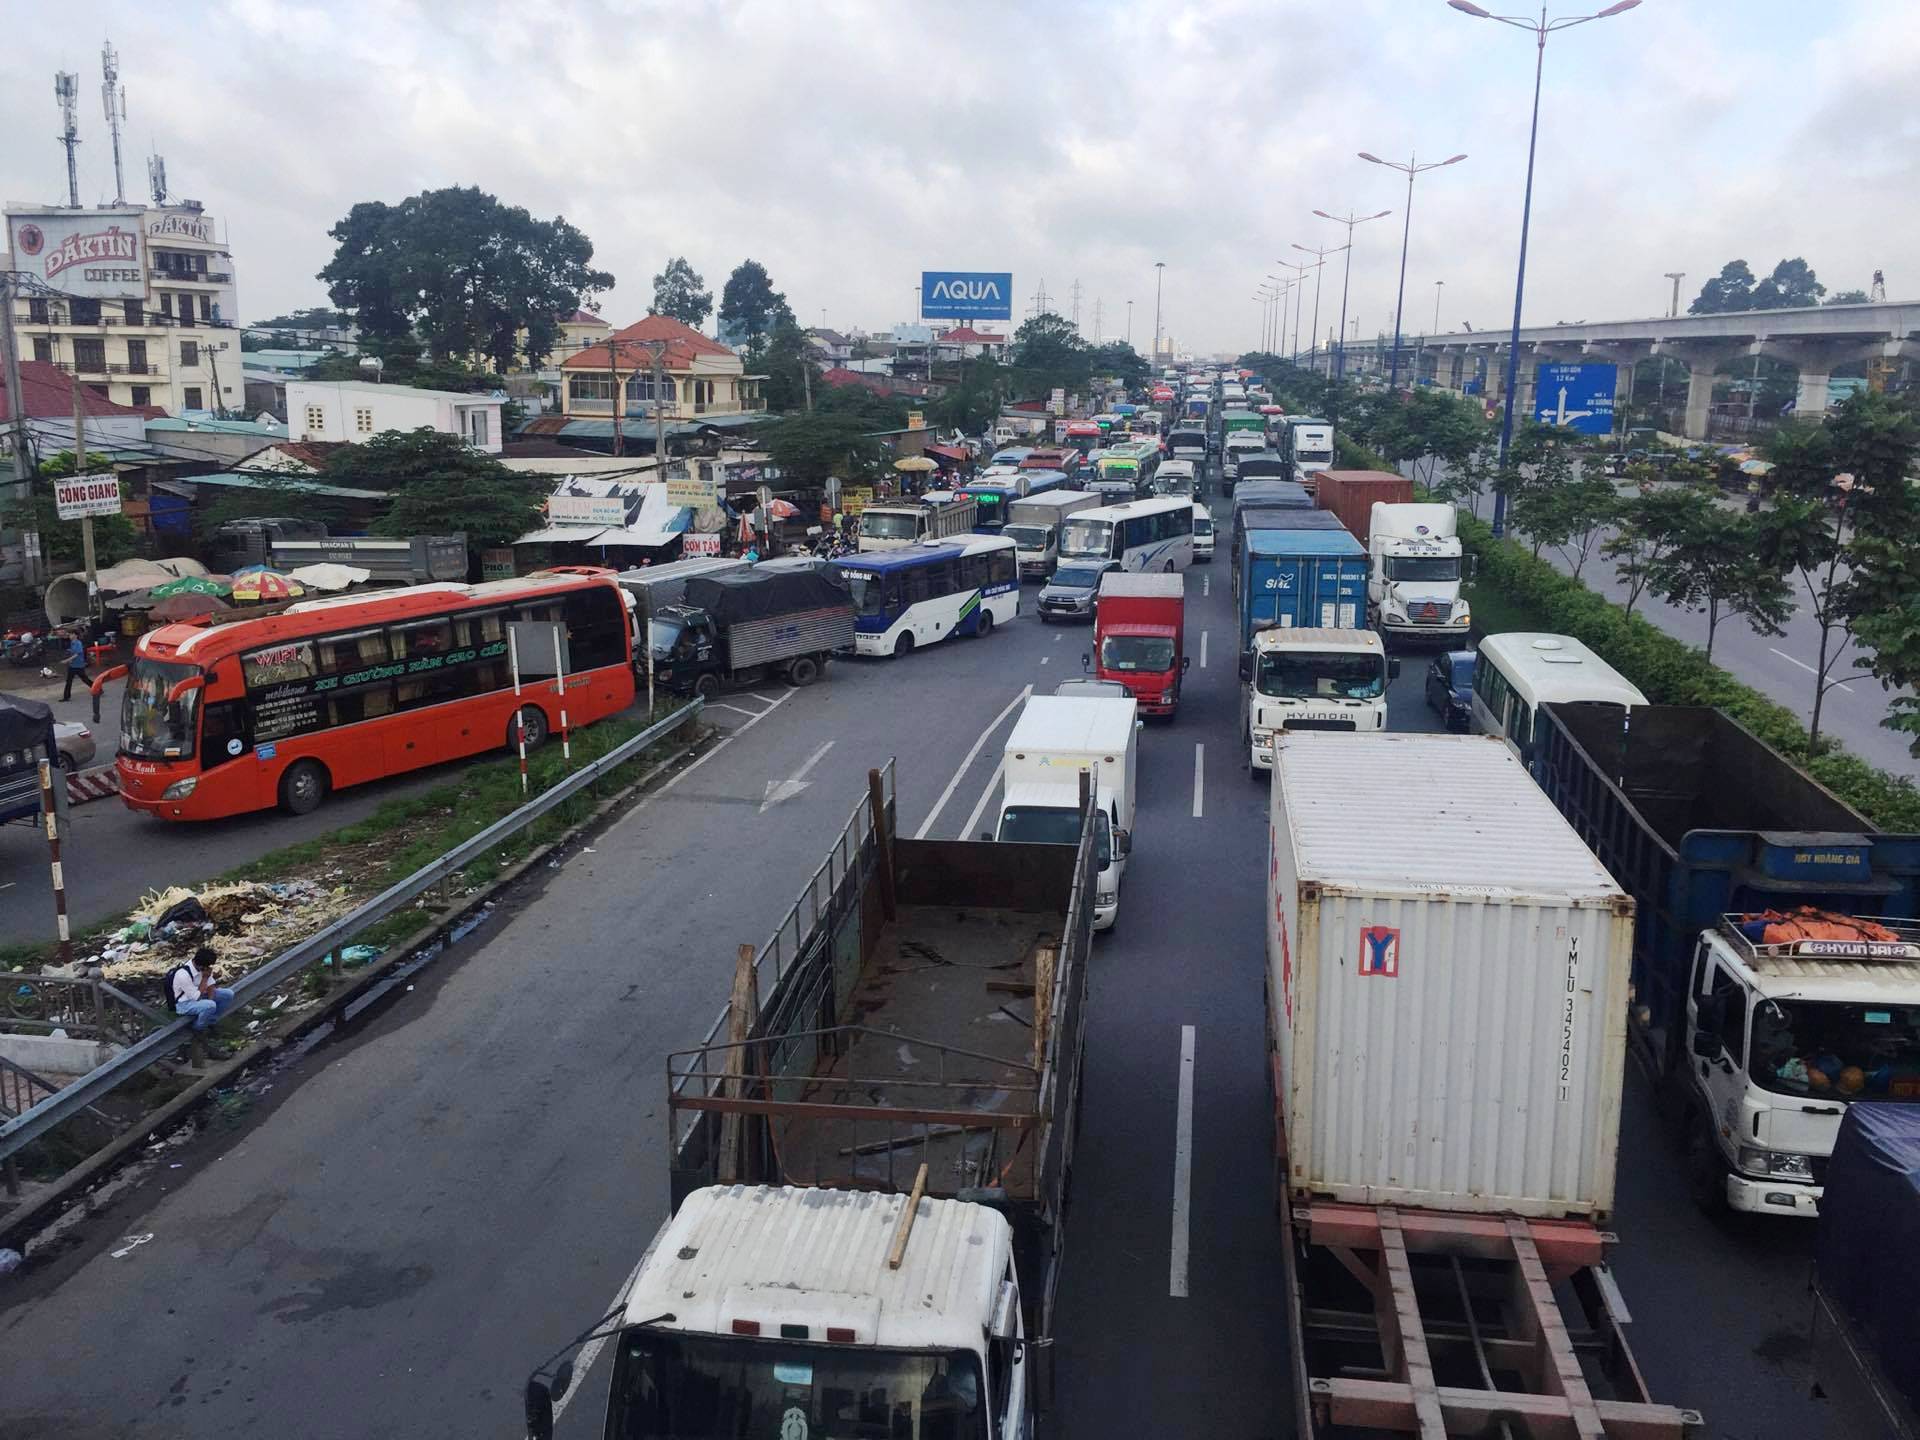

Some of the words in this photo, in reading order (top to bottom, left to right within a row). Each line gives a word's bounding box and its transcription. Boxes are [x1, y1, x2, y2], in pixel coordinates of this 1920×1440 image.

[84, 268, 141, 282] COFFEE
[932, 280, 1000, 300] AQUA
[88, 482, 118, 501] GIANG
[255, 646, 297, 667] WIFI
[1286, 712, 1354, 720] HYUNDAI
[1826, 941, 1893, 956] HYUNDAI
[1565, 936, 1579, 993] YMLU
[1560, 998, 1574, 1081] 345402
[1561, 1087, 1568, 1100] 1
